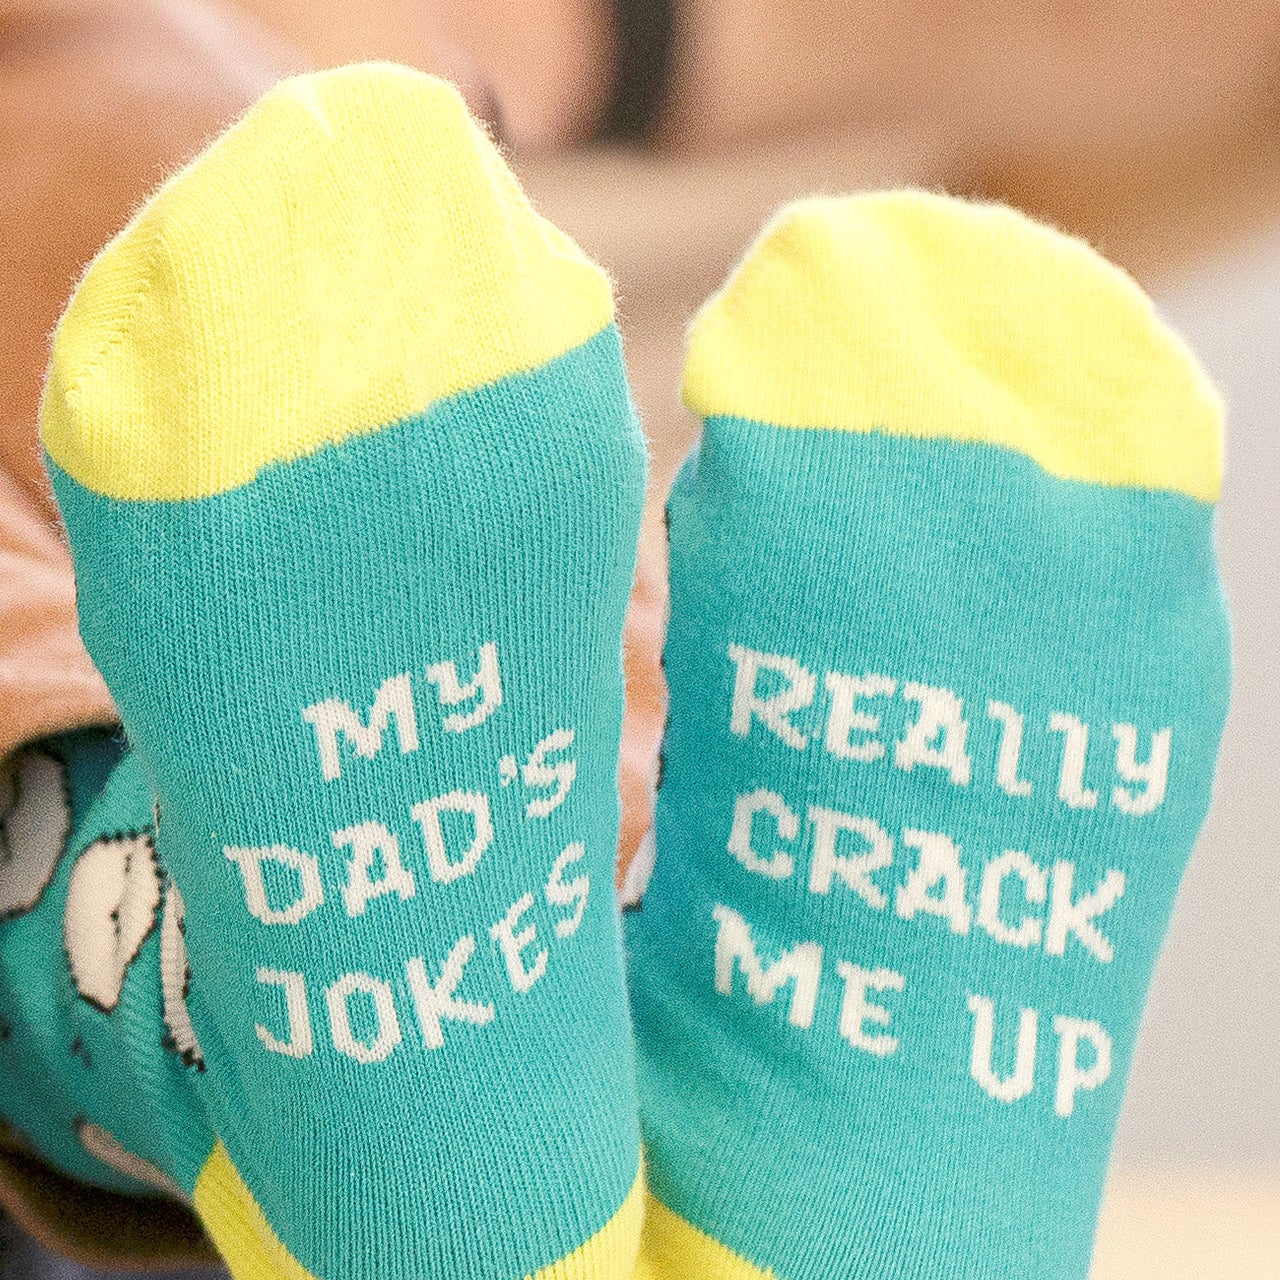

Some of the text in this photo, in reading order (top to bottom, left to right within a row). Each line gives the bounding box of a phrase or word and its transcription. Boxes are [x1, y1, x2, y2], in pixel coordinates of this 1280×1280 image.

[301, 641, 503, 782] MY
[727, 642, 1173, 817] REALLY
[222, 728, 578, 926] DAD'S
[727, 789, 1127, 963] CRACK
[254, 841, 591, 1064] JOKES
[711, 903, 1114, 1118] ME UP
